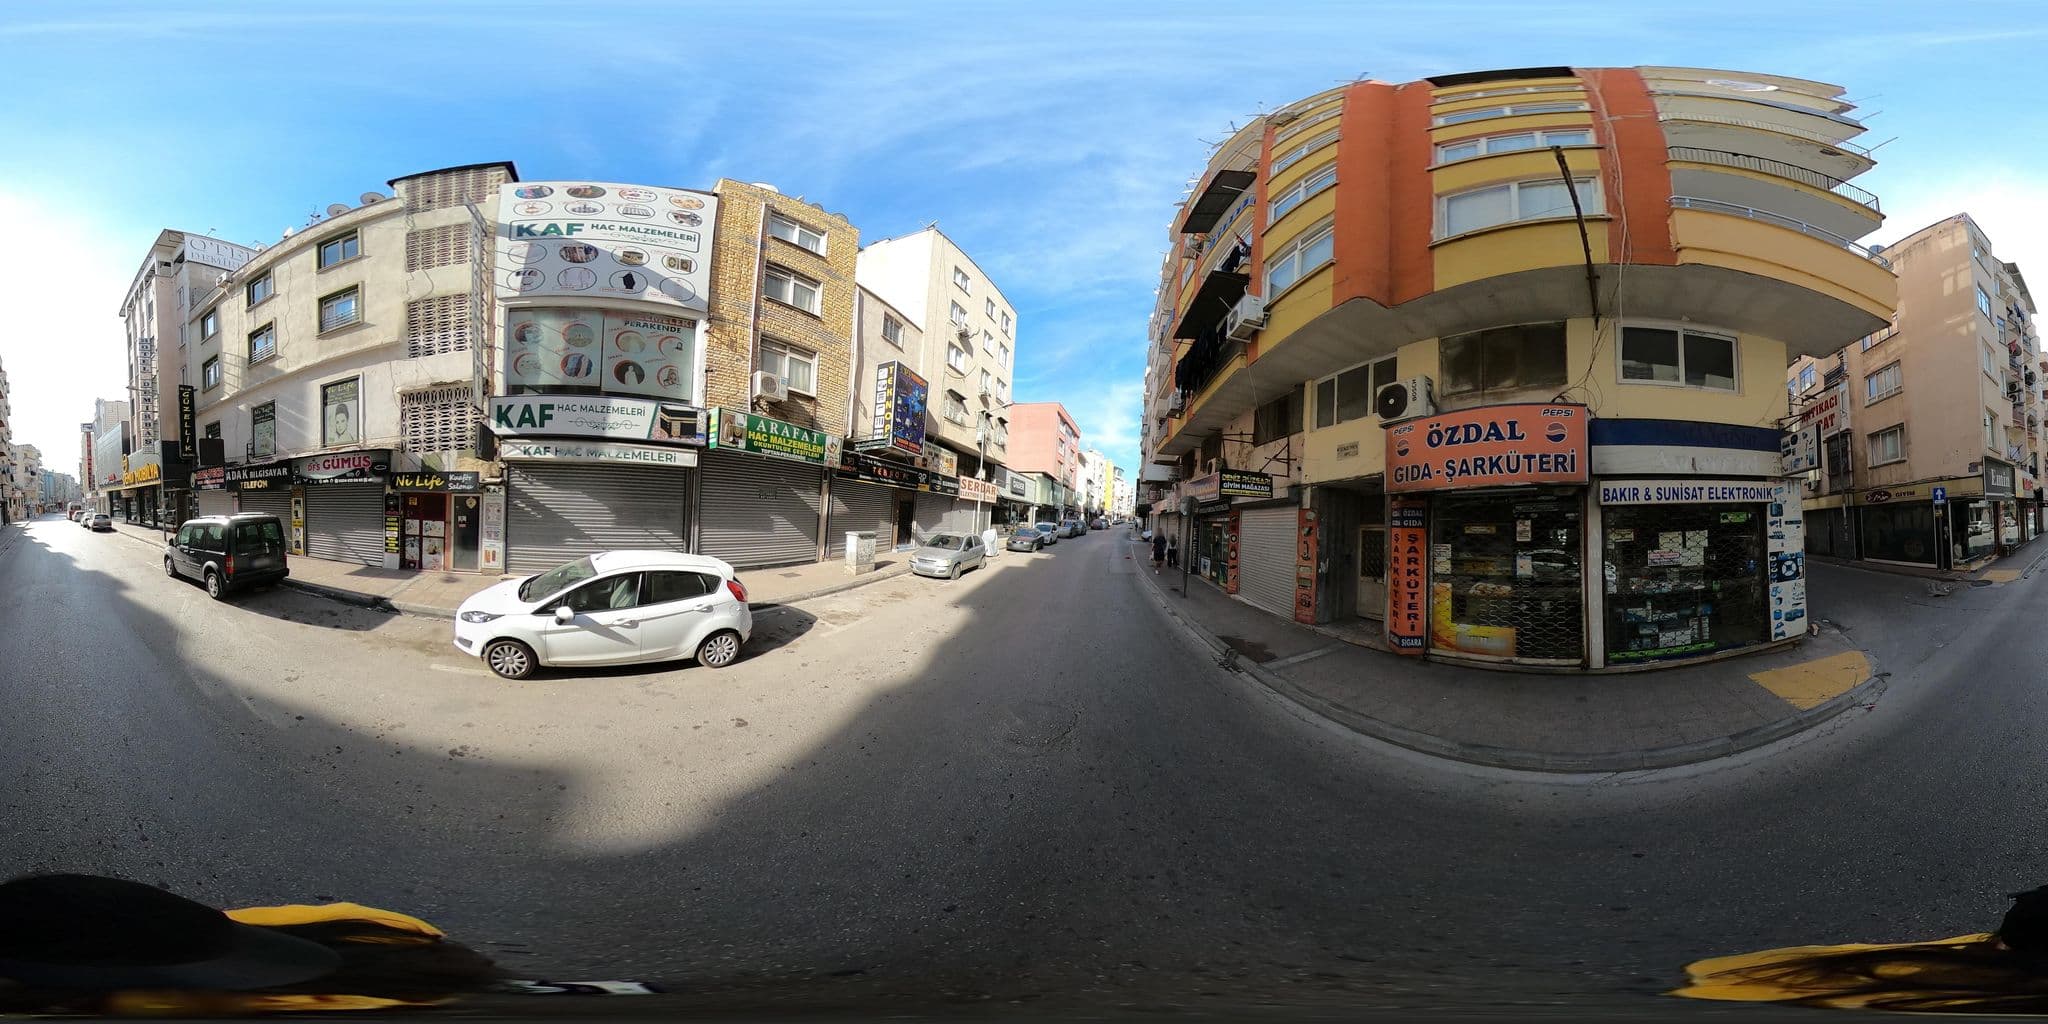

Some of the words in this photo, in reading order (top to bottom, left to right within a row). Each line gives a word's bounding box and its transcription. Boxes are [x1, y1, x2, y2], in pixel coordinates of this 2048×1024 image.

[516, 223, 584, 237] KAF
[591, 223, 616, 231] HAC
[619, 224, 697, 242] MALZEMELERİ
[624, 320, 682, 334] PERAKENDE
[496, 403, 555, 429] KAF
[557, 404, 577, 412] HAC
[580, 404, 647, 417] MALZEMELERİ
[1542, 408, 1575, 418] PEPSI
[747, 430, 768, 442] HAC
[756, 419, 820, 444] ARAFAT
[1393, 424, 1415, 436] PEPSI
[1426, 420, 1526, 448] ÖZDAL
[523, 446, 551, 456] KAF
[1445, 449, 1577, 482] ŞARKÜTERİ
[226, 469, 248, 481] ADAK
[396, 474, 413, 487] Ni
[416, 474, 445, 490] Life
[961, 478, 997, 496] SERDAR
[1603, 487, 1640, 502] BAKIR
[1644, 487, 1652, 501] &
[1406, 533, 1419, 632] ŞARKÜTERİ
